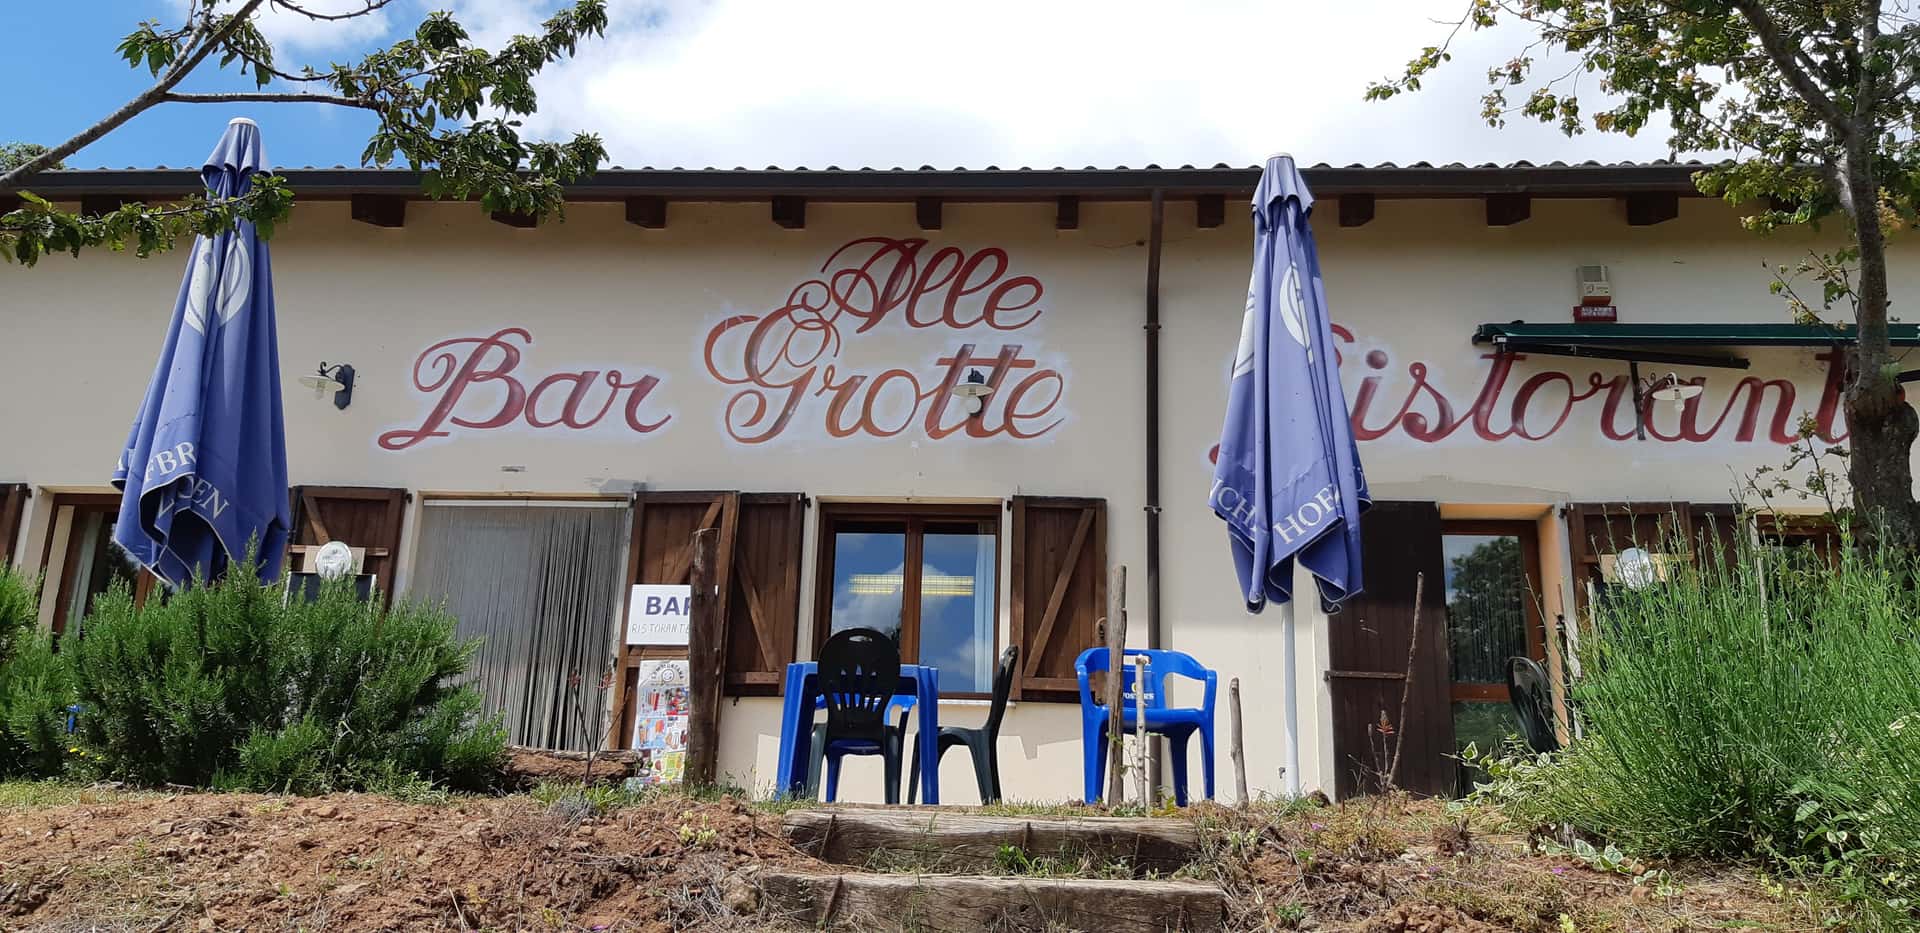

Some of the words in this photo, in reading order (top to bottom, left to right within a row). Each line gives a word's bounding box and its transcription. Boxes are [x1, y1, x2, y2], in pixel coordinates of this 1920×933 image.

[820, 237, 1044, 333] Alle
[378, 327, 672, 450] Bar
[703, 280, 1065, 444] Grotte
[1208, 322, 1906, 466] istorant
